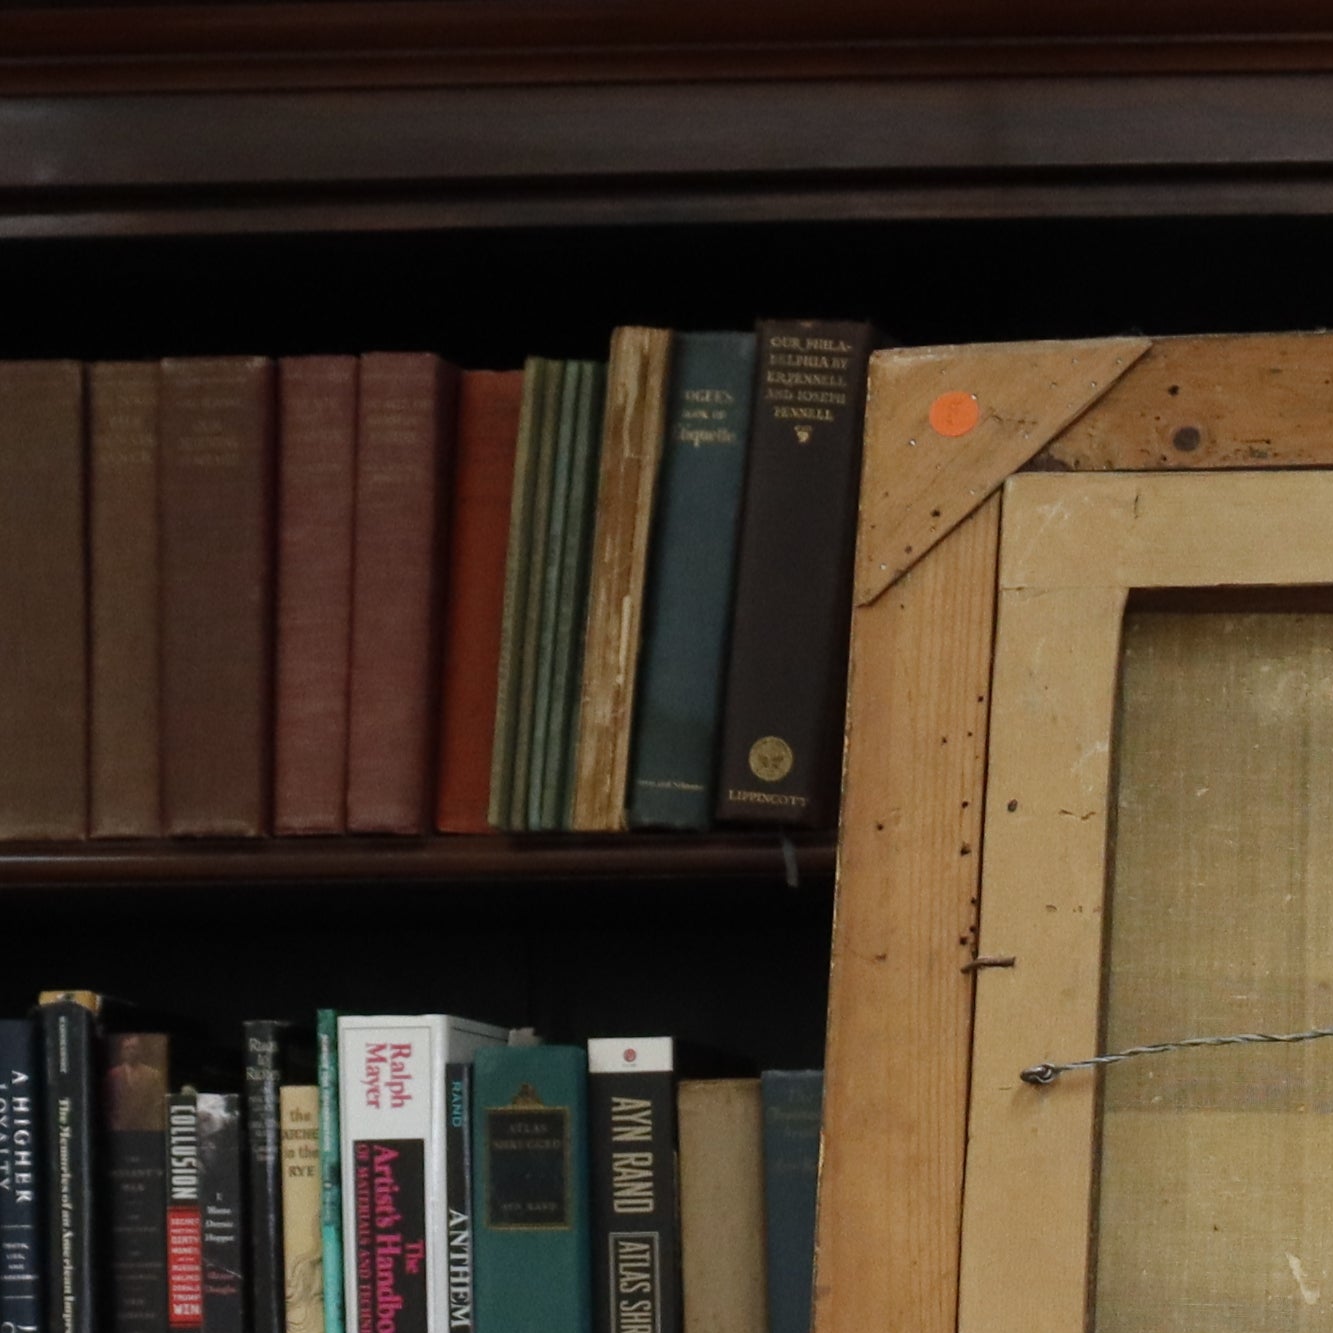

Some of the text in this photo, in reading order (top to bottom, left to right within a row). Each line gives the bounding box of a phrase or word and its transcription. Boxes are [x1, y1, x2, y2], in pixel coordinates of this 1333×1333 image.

[360, 1043, 387, 1110] Mayer
[385, 1043, 412, 1110] Ralph
[451, 1081, 462, 1128] RAND
[12, 1070, 34, 1204] A HIGHER
[289, 1107, 312, 1122] the
[170, 1104, 198, 1200] COLLUSION
[288, 1165, 316, 1178] RYE
[612, 1097, 653, 1214] AYN RAND
[61, 1230, 75, 1294] American
[405, 1239, 424, 1275] The
[449, 1209, 472, 1327] ANTHEM
[619, 1241, 652, 1294] ATLAS
[173, 1303, 201, 1315] WIN
